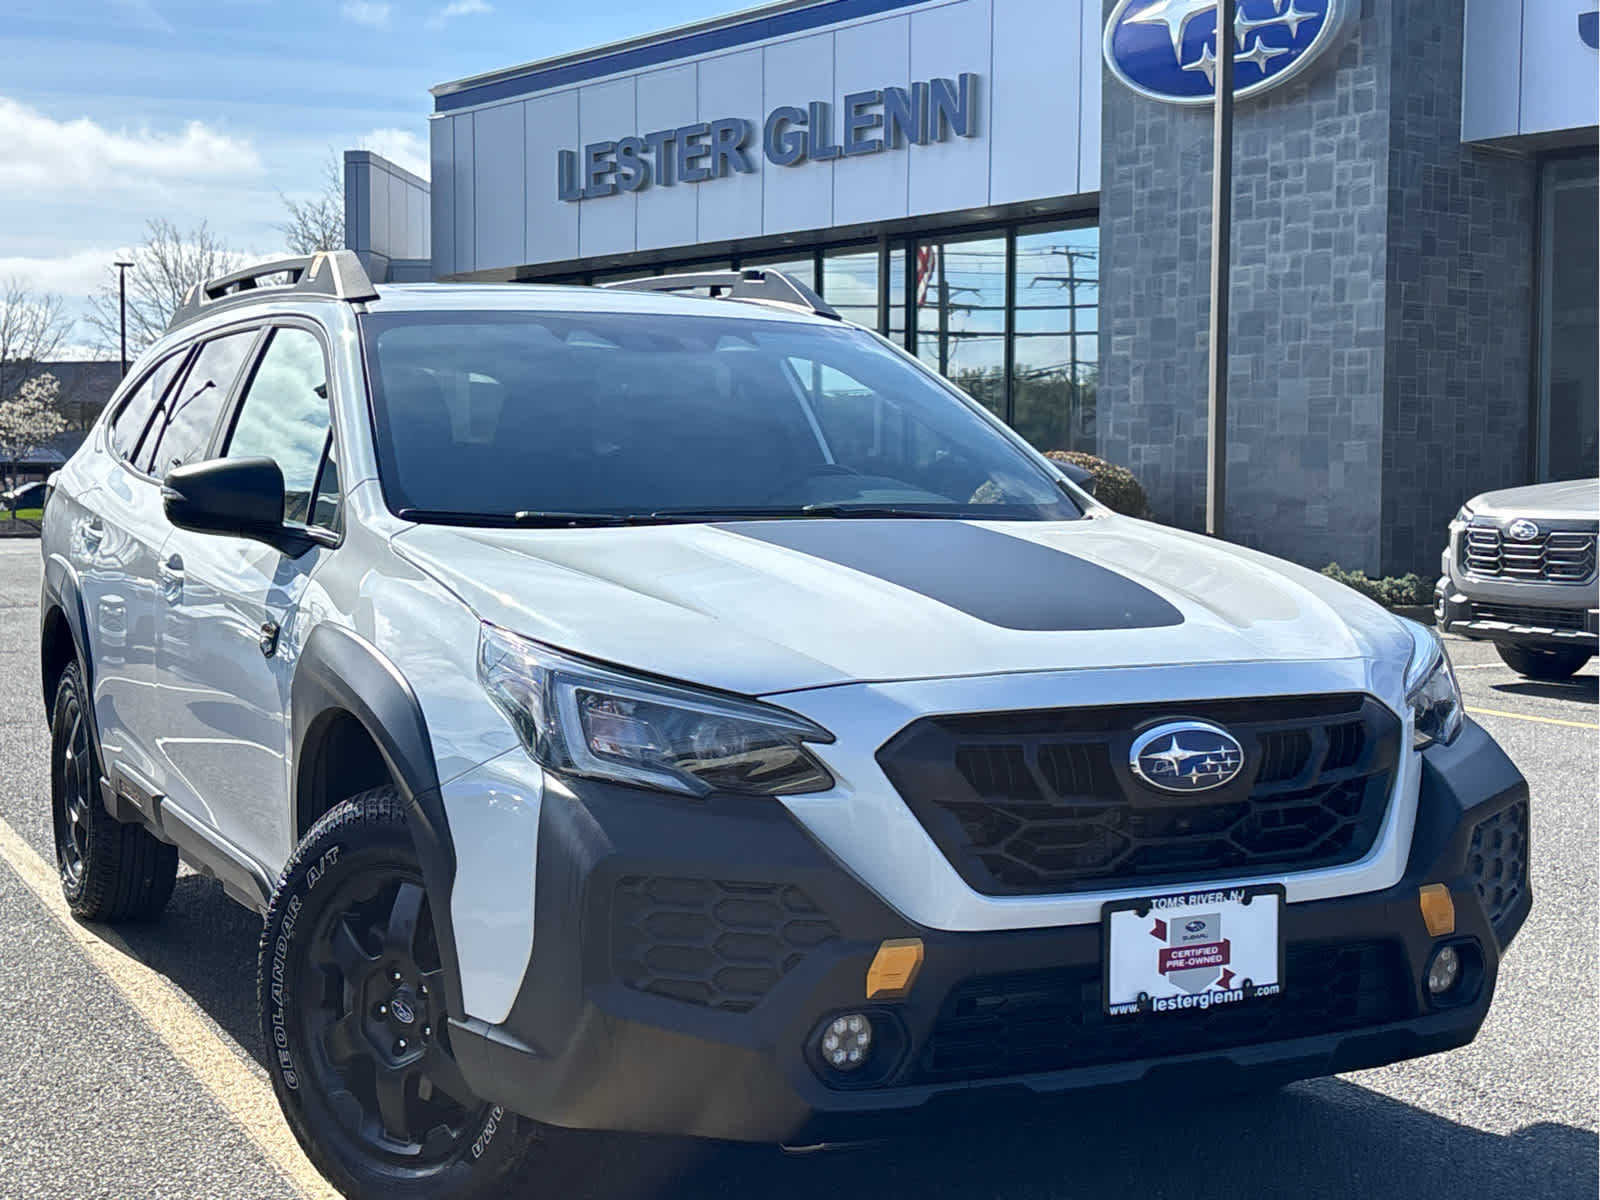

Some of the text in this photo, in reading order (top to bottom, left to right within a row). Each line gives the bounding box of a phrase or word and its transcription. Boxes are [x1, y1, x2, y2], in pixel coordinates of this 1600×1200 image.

[558, 72, 979, 202] LESTER GLENN
[1151, 896, 1185, 909] TOMS
[1230, 889, 1245, 901] NJ
[1166, 954, 1223, 968] PRE-OWNED
[1171, 946, 1218, 958] CERTIFIED
[271, 845, 340, 1090] GEOLANDAR A/T
[1152, 989, 1243, 1012] lesterglenn
